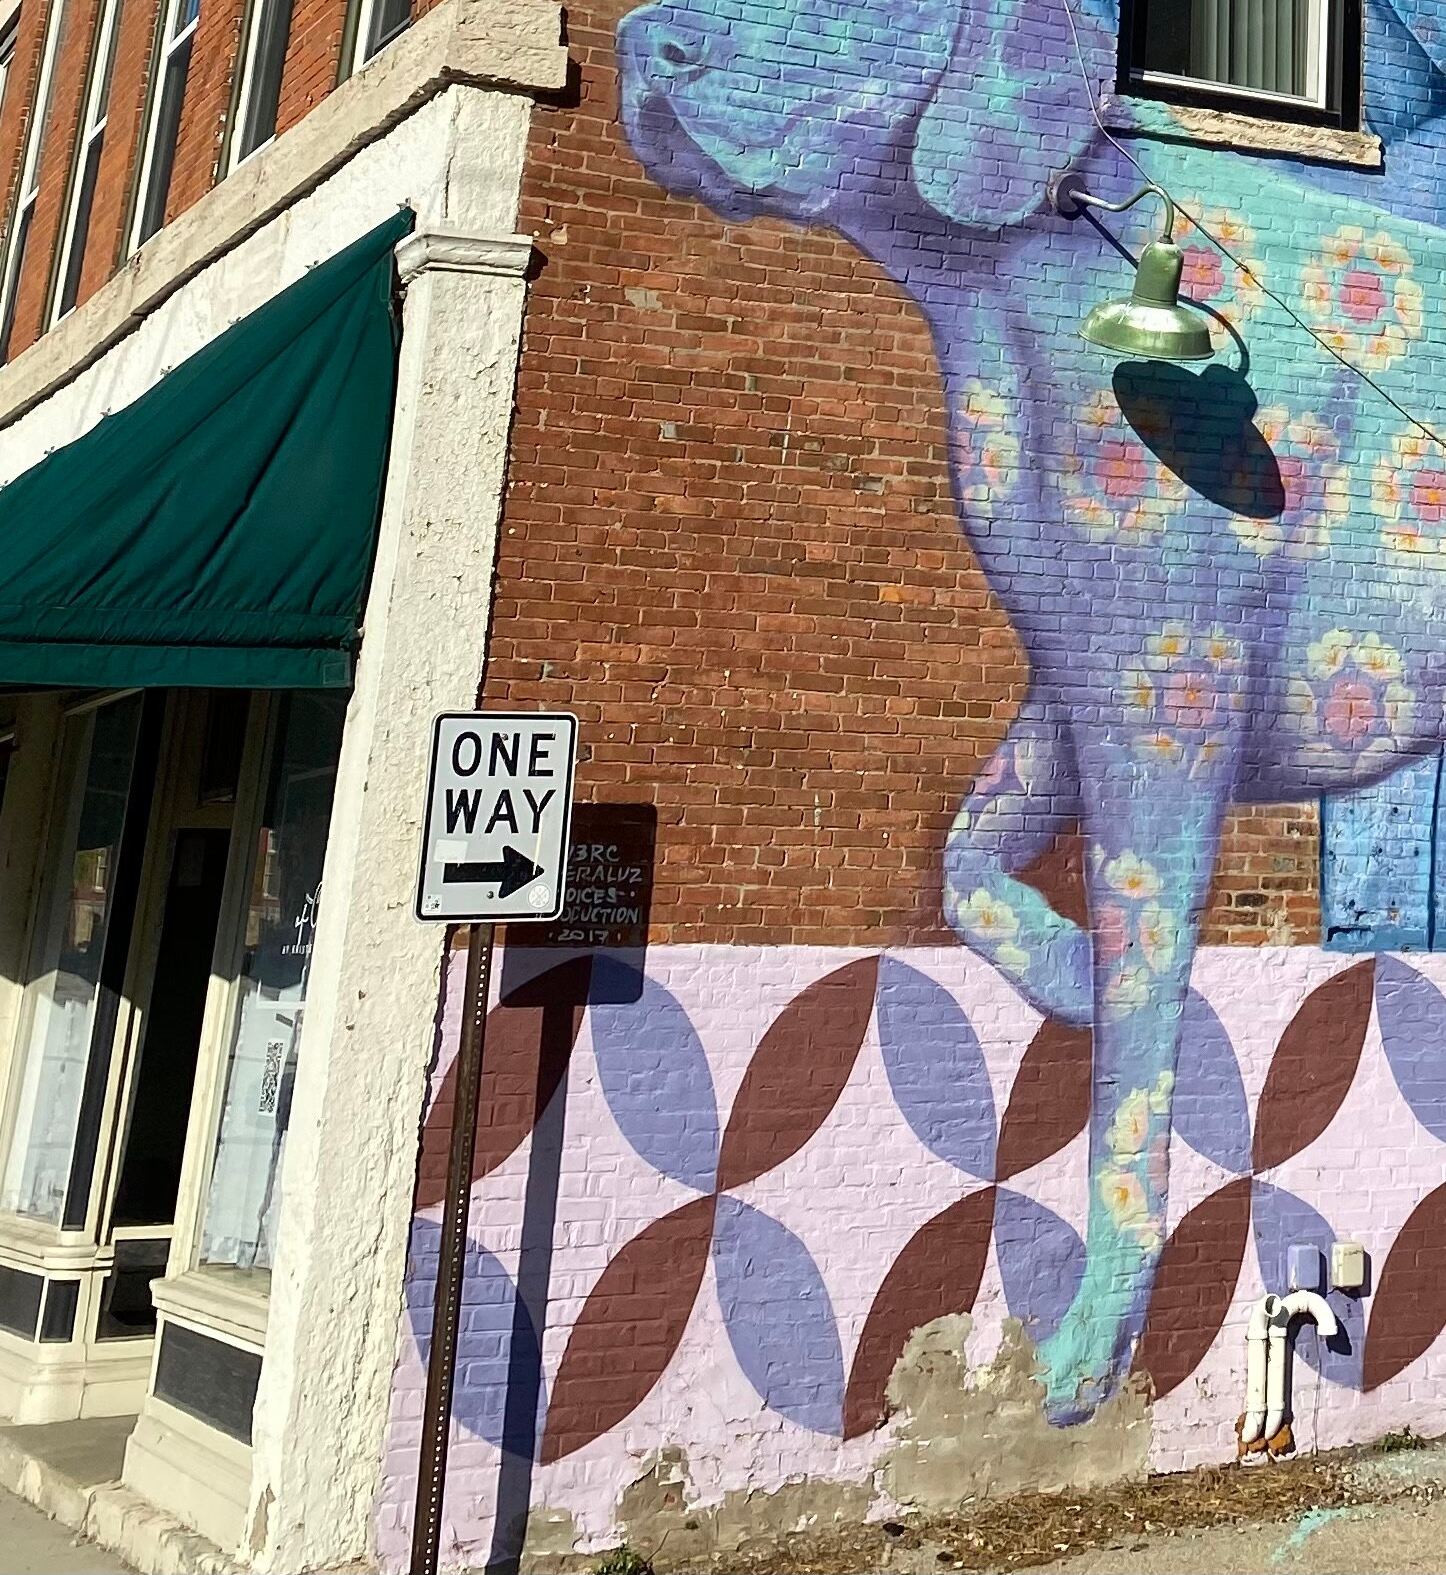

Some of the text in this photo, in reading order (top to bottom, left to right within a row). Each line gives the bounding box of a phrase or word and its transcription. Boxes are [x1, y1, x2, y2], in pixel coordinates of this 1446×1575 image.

[452, 731, 556, 777] ONE
[445, 789, 556, 834] WAY
[566, 865, 642, 883] ERALUZ
[560, 906, 639, 924] ODUCTION
[558, 929, 609, 943] 2017
